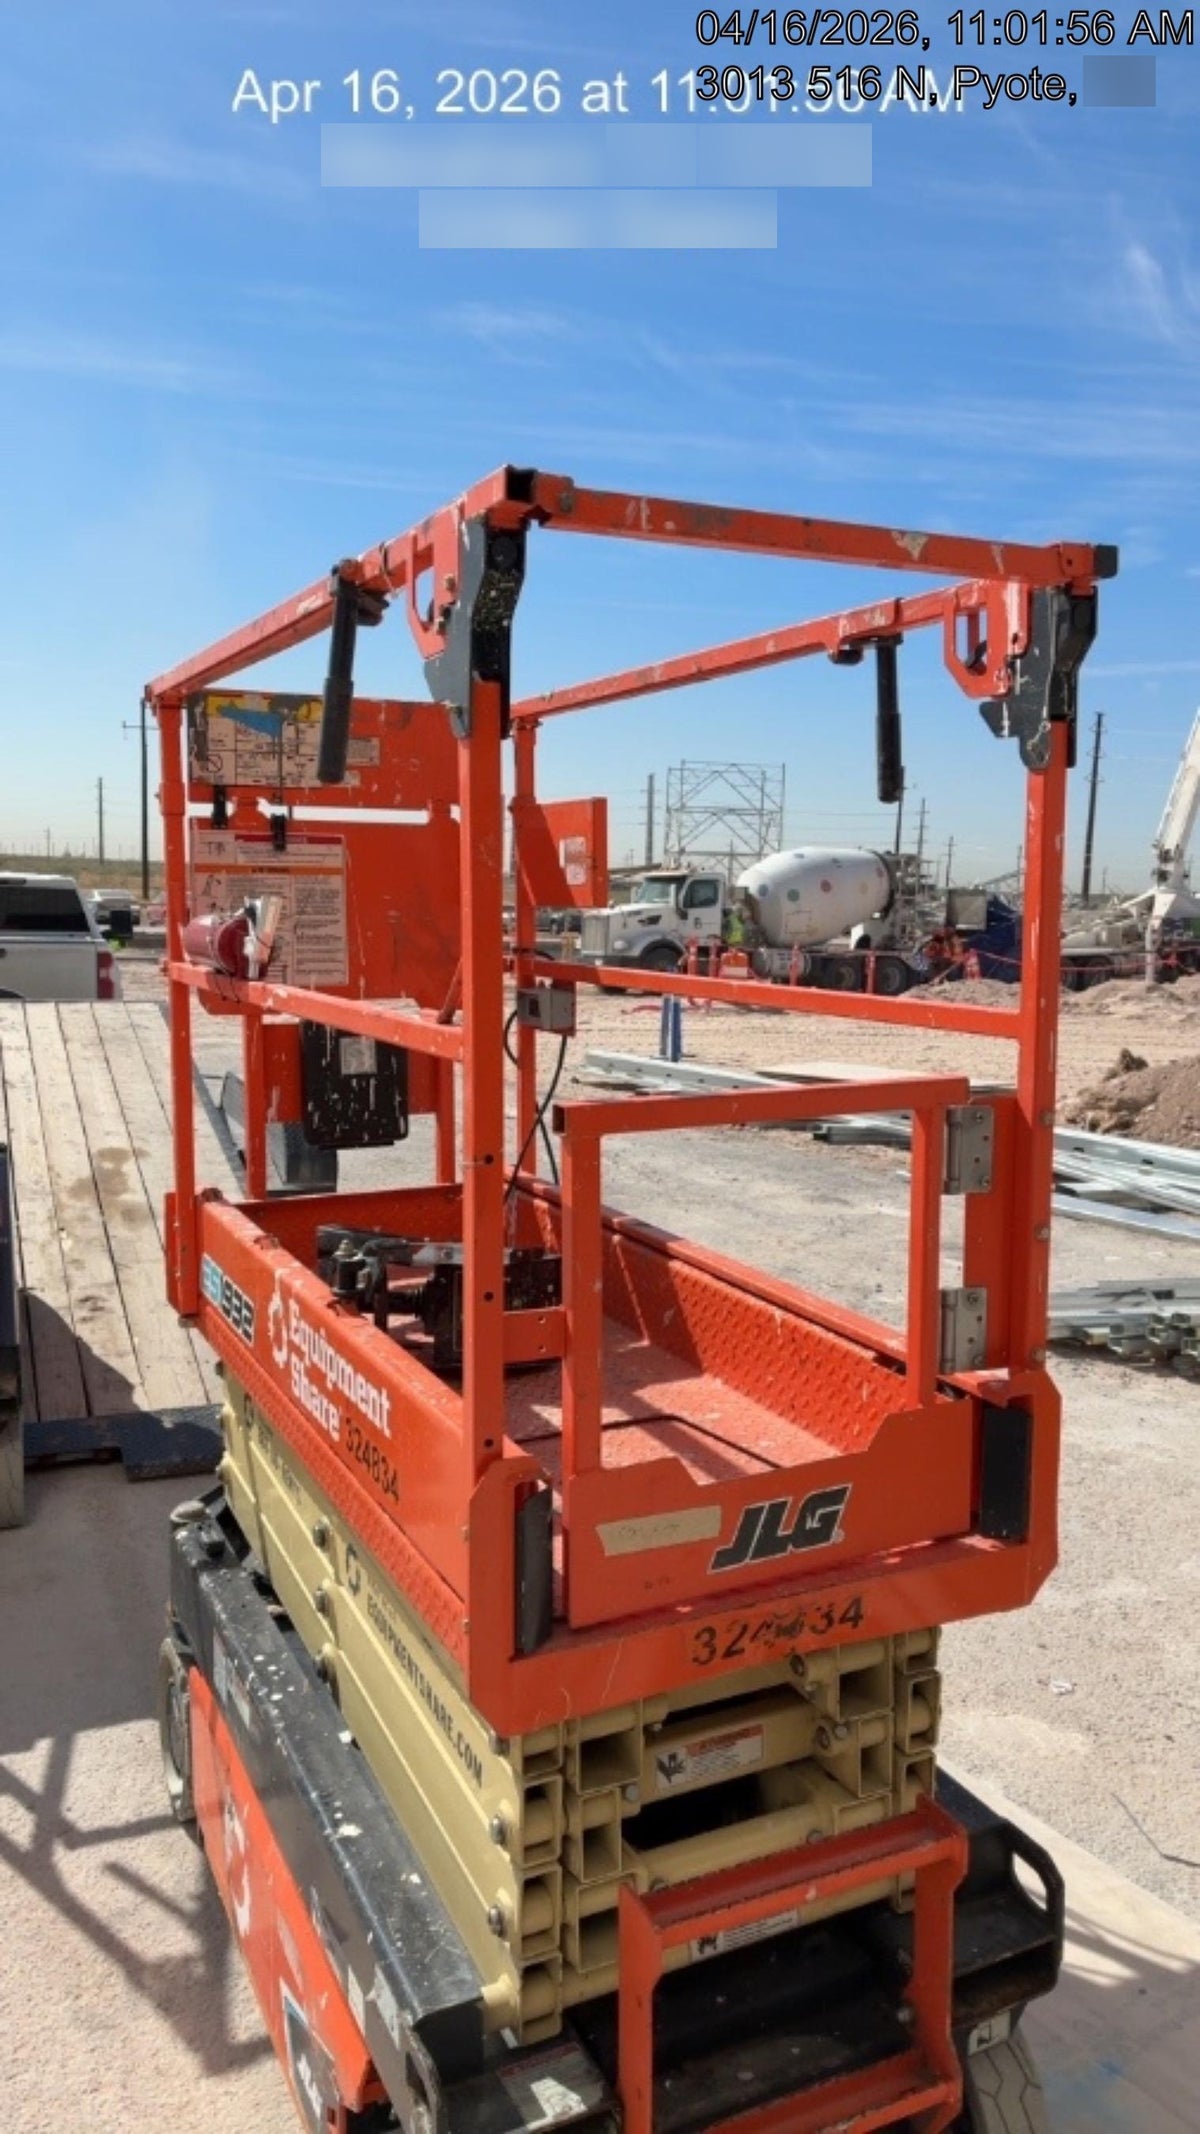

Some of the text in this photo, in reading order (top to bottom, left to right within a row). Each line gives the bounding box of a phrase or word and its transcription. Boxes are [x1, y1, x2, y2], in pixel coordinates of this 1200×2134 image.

[289, 1298, 392, 1440] Equipment
[290, 1350, 340, 1443] Share
[706, 1483, 853, 1575] JLG
[366, 1592, 483, 1789] EQUIPMENTSHARE.COM
